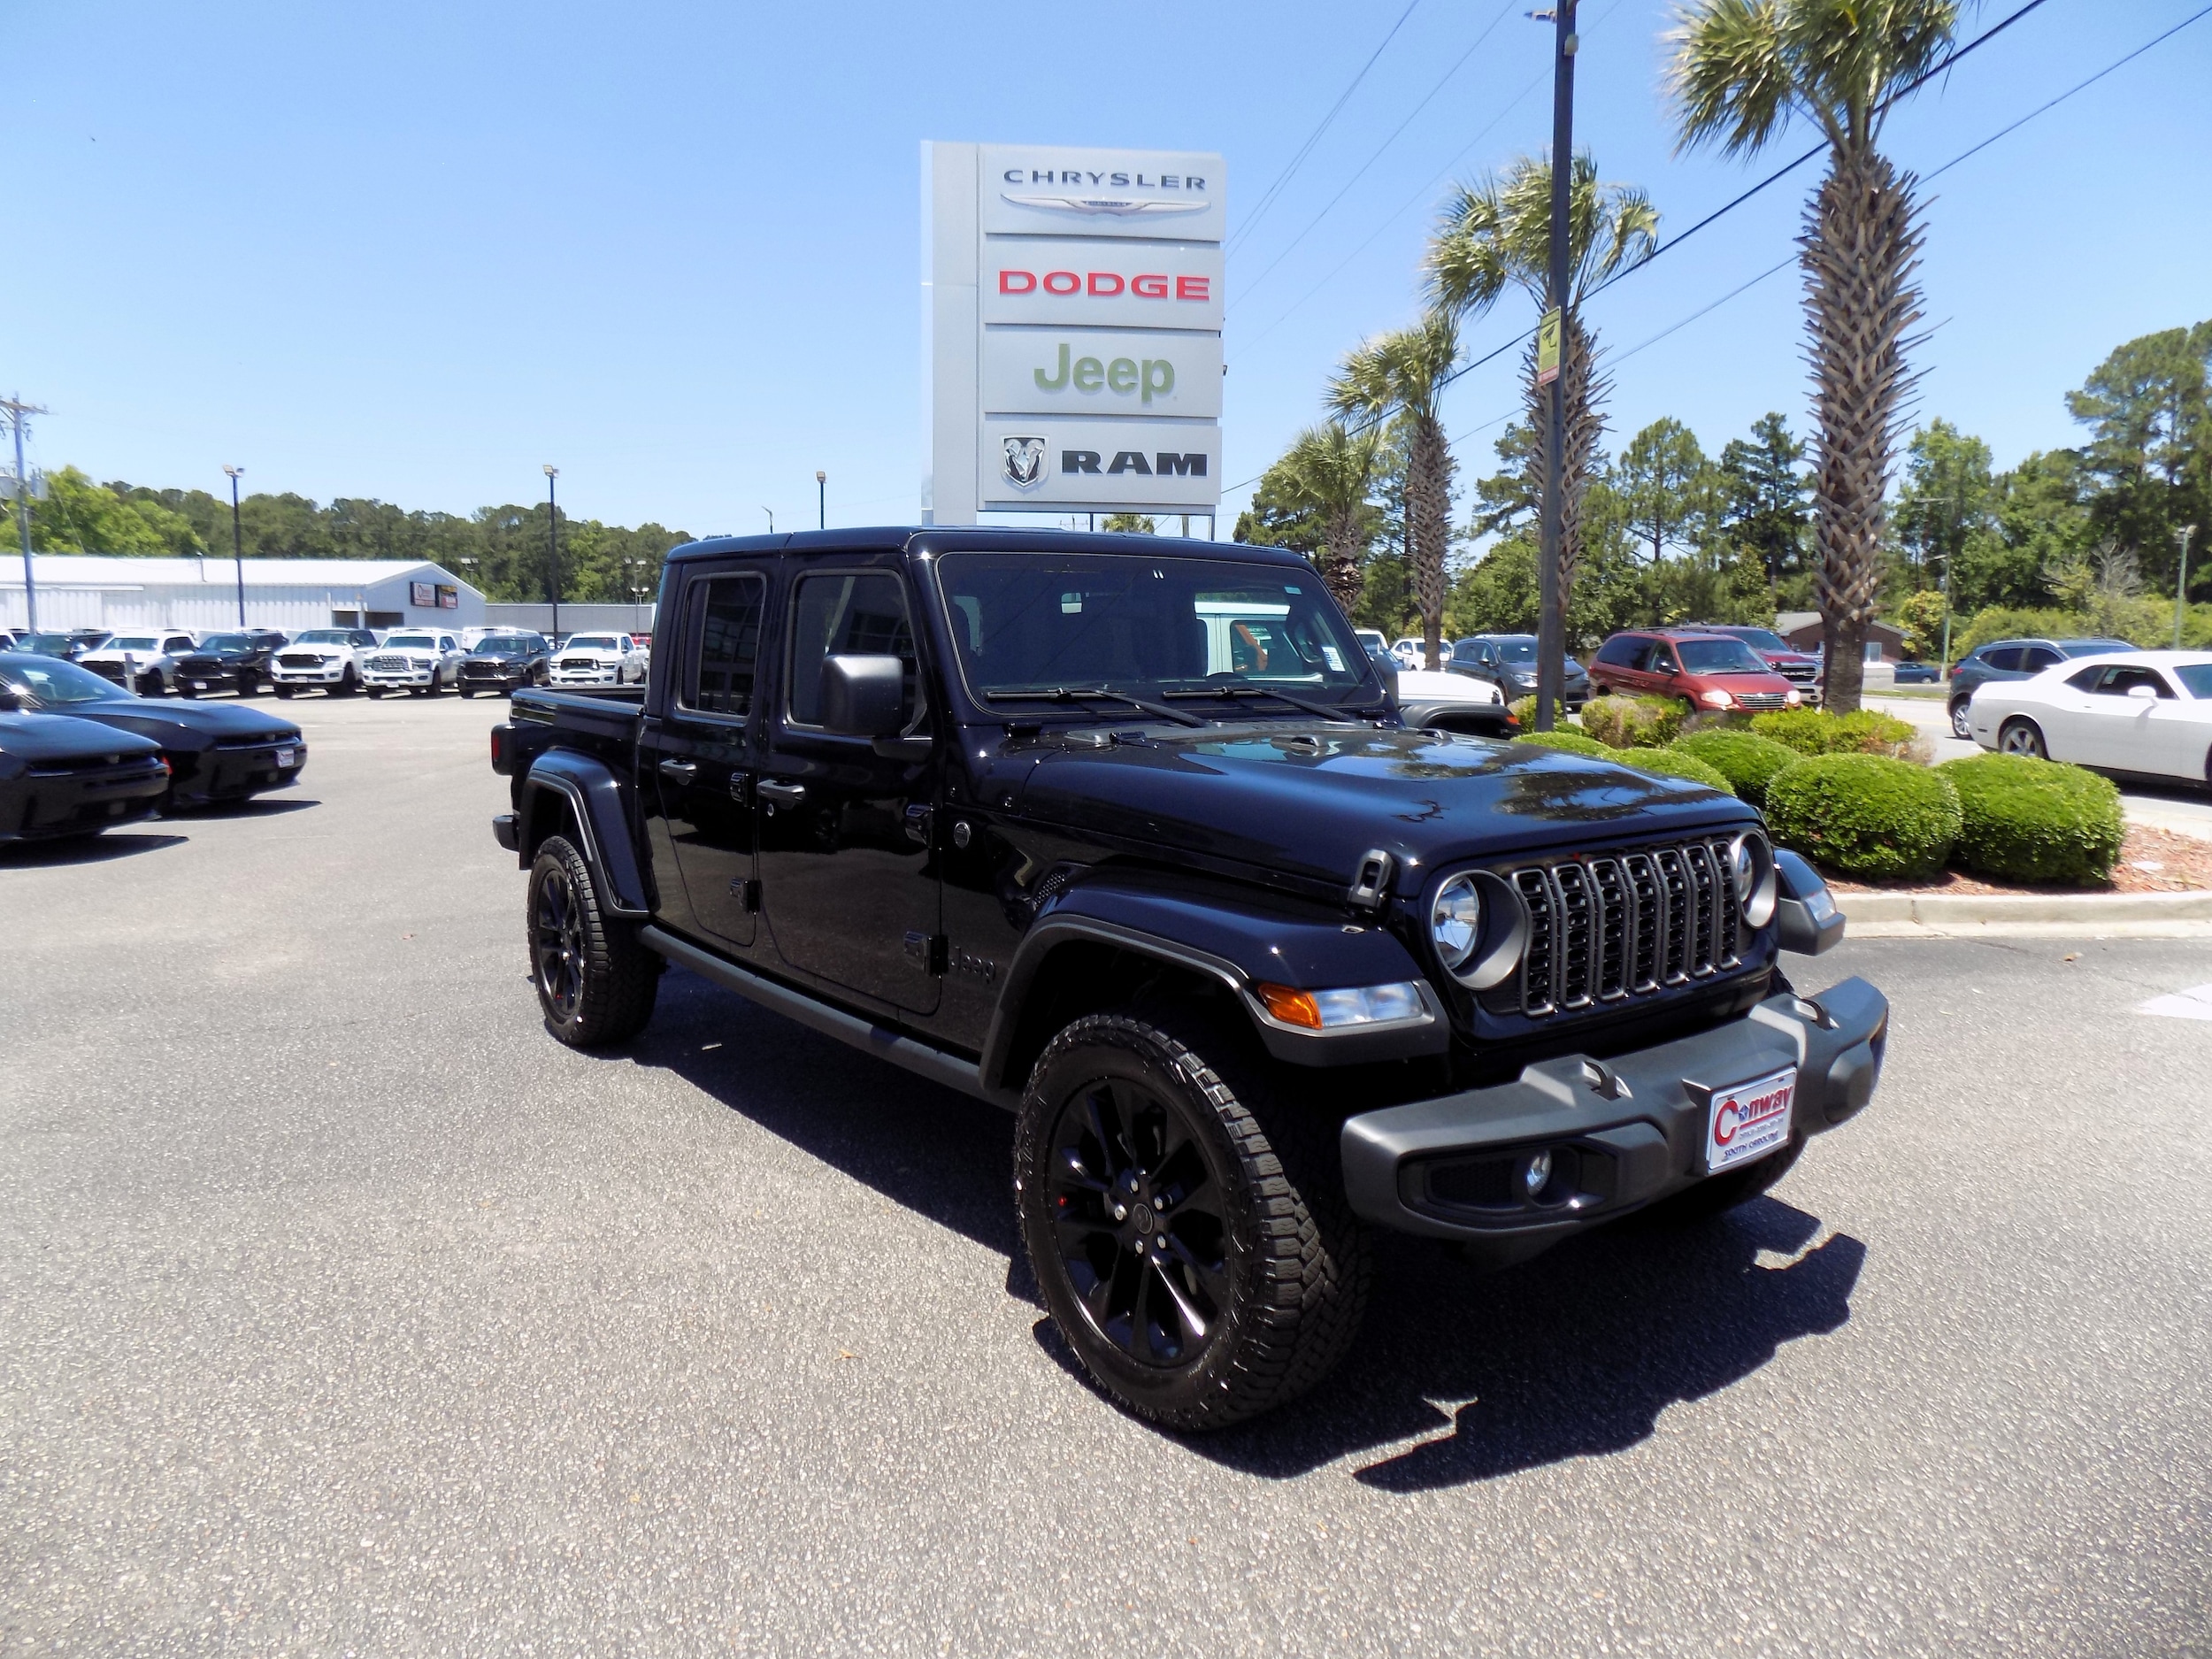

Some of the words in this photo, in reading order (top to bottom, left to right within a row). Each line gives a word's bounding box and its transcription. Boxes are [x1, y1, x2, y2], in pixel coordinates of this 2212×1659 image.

[1003, 169, 1206, 190] CHRYSLER
[999, 271, 1210, 301] DODGE
[1033, 343, 1175, 403] Jeep
[1062, 449, 1208, 476] RAM
